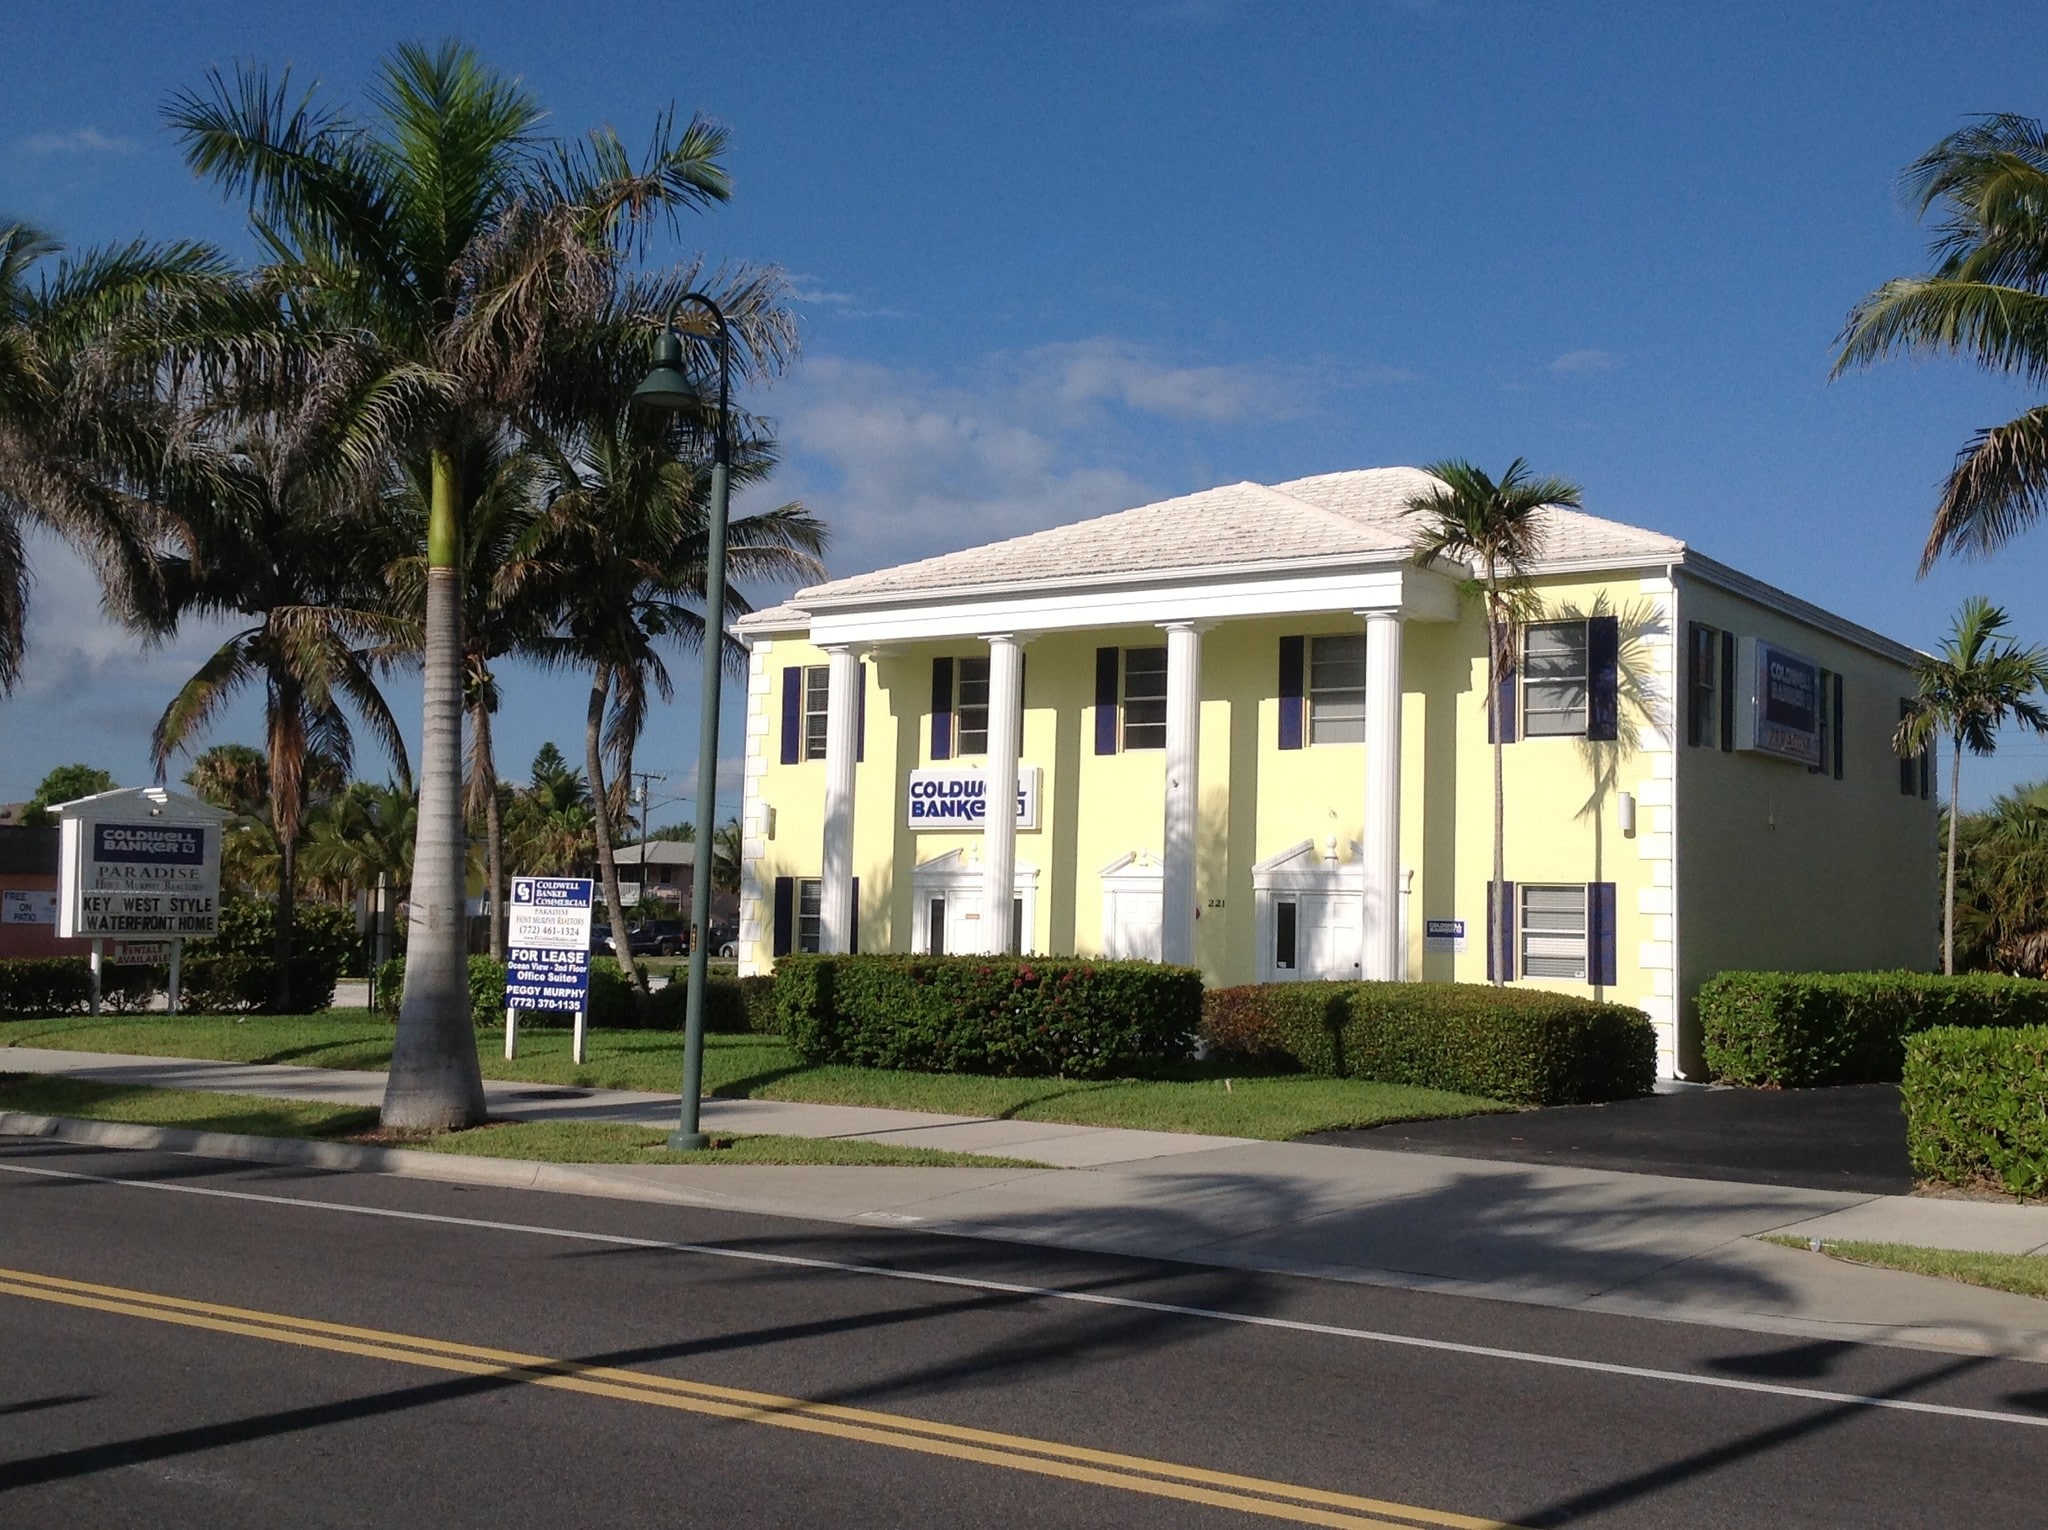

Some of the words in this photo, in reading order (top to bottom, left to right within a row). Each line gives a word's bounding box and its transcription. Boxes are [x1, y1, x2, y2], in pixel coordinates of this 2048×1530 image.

[911, 780, 1027, 798] COLDWL
[911, 799, 987, 821] BANKE
[103, 829, 196, 843] COLDWELL
[103, 839, 180, 854] BANKER
[99, 866, 200, 880] PARADISE
[536, 881, 580, 890] COLDWELL
[4, 892, 27, 901] FREE
[536, 889, 568, 898] BANKER
[19, 902, 32, 912] ON
[83, 897, 111, 912] KEY
[123, 897, 160, 912] WEST
[170, 898, 212, 913] STYLE
[535, 898, 588, 907] COMMERCIAL
[1208, 899, 1225, 908] 221
[534, 908, 569, 916] PARADISE
[87, 915, 176, 931] WATERFRONT
[178, 916, 213, 931] HOME
[519, 925, 540, 935] (772)
[543, 926, 580, 936] 461-1324
[511, 949, 538, 962] FOR
[541, 950, 585, 963] LEASE
[507, 962, 530, 970] Ocean
[531, 962, 549, 971] View
[554, 963, 567, 972] 2nd
[569, 964, 587, 973] Floor
[517, 971, 545, 981] Office
[547, 972, 577, 983] Suites
[506, 985, 542, 996] PEGGY
[543, 986, 586, 999] MURPHY
[509, 997, 536, 1009] (772)
[537, 998, 581, 1010] 370-1135
